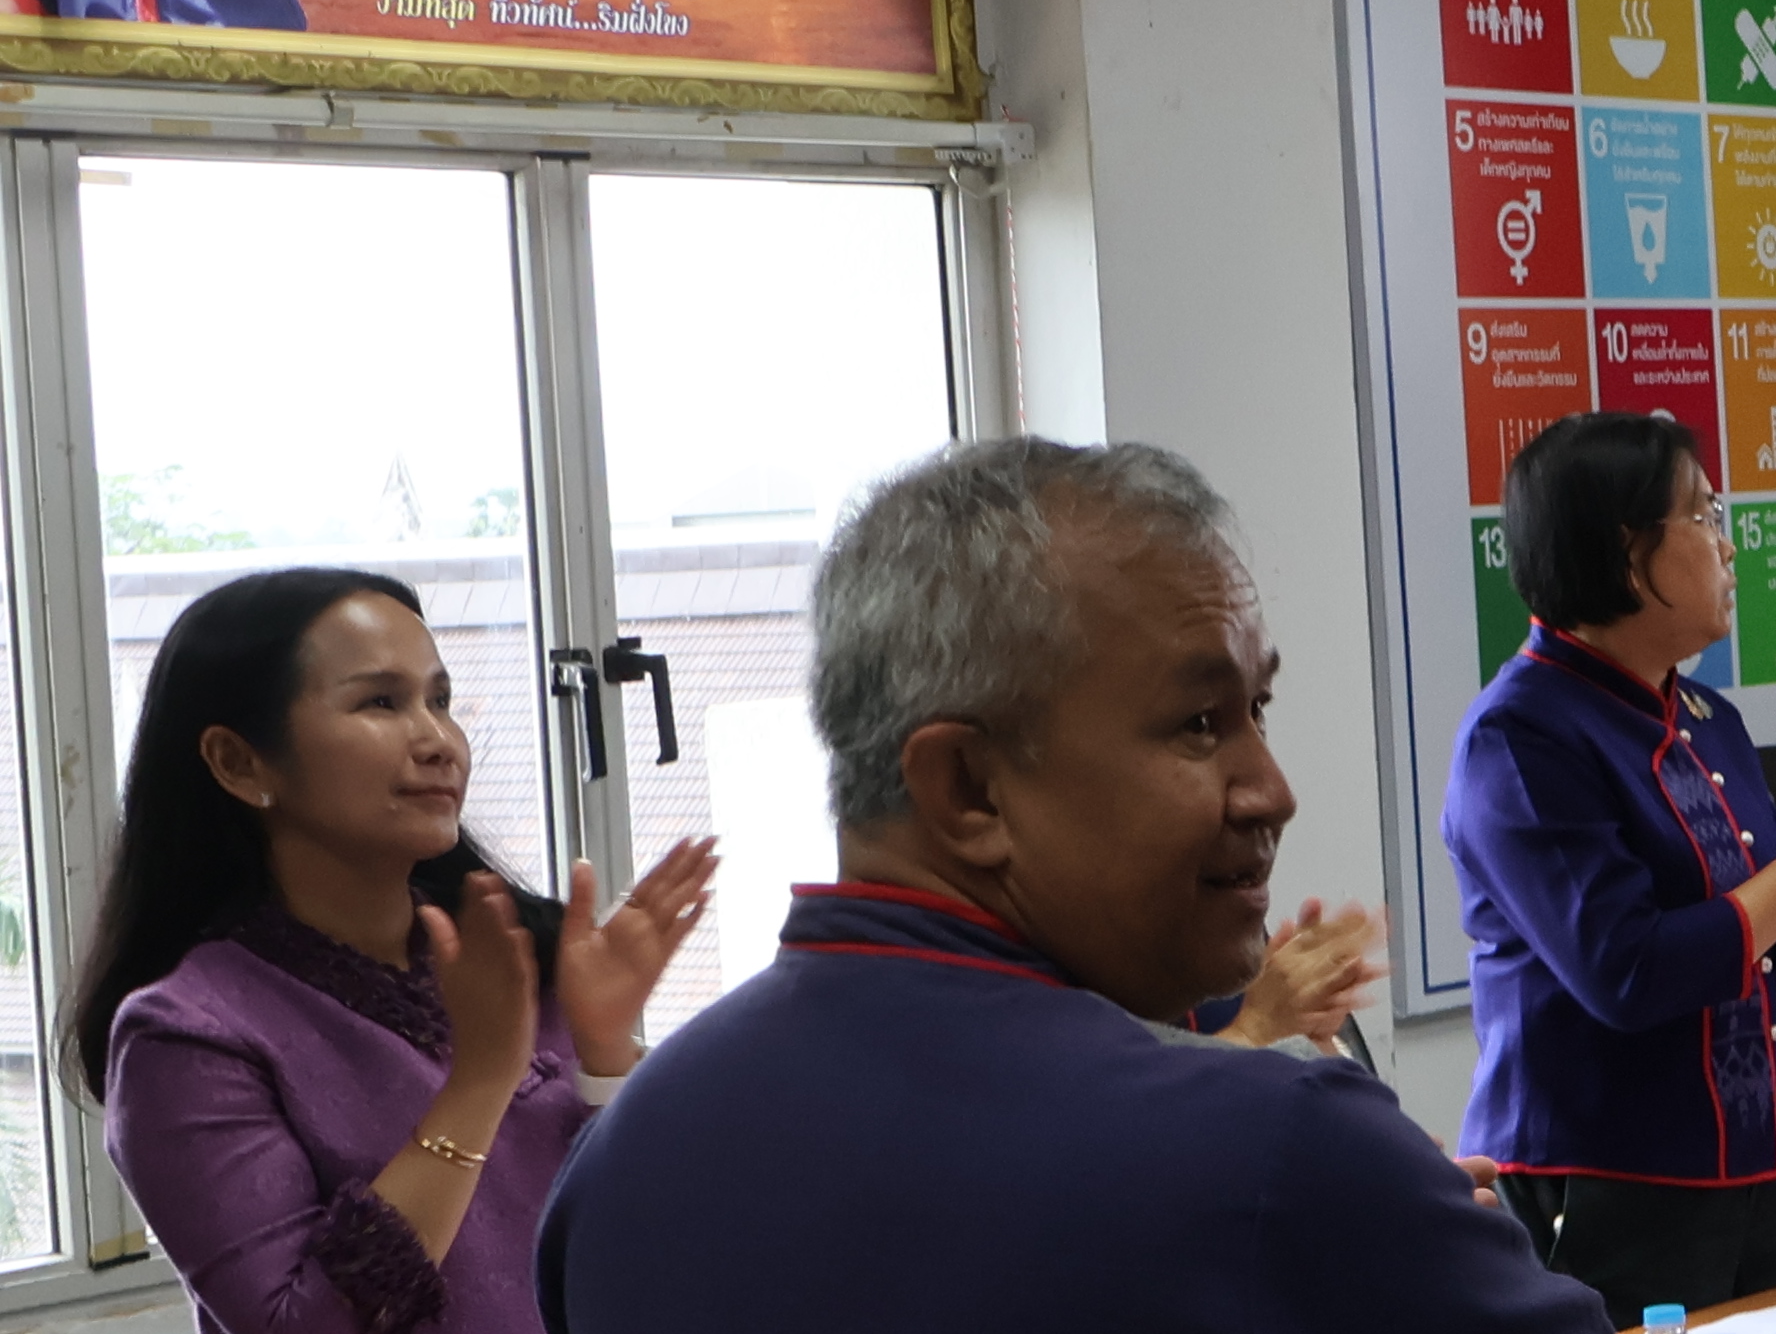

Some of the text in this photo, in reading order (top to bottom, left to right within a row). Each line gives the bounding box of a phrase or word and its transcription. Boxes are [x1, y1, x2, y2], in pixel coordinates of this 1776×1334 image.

[1454, 109, 1475, 153] 5
[1588, 118, 1609, 158] 6
[1713, 124, 1730, 164] 7
[1466, 321, 1488, 365] 9
[1602, 321, 1629, 364] 10
[1727, 322, 1750, 361] 11
[1478, 526, 1507, 569] 13
[1737, 511, 1763, 551] 15
